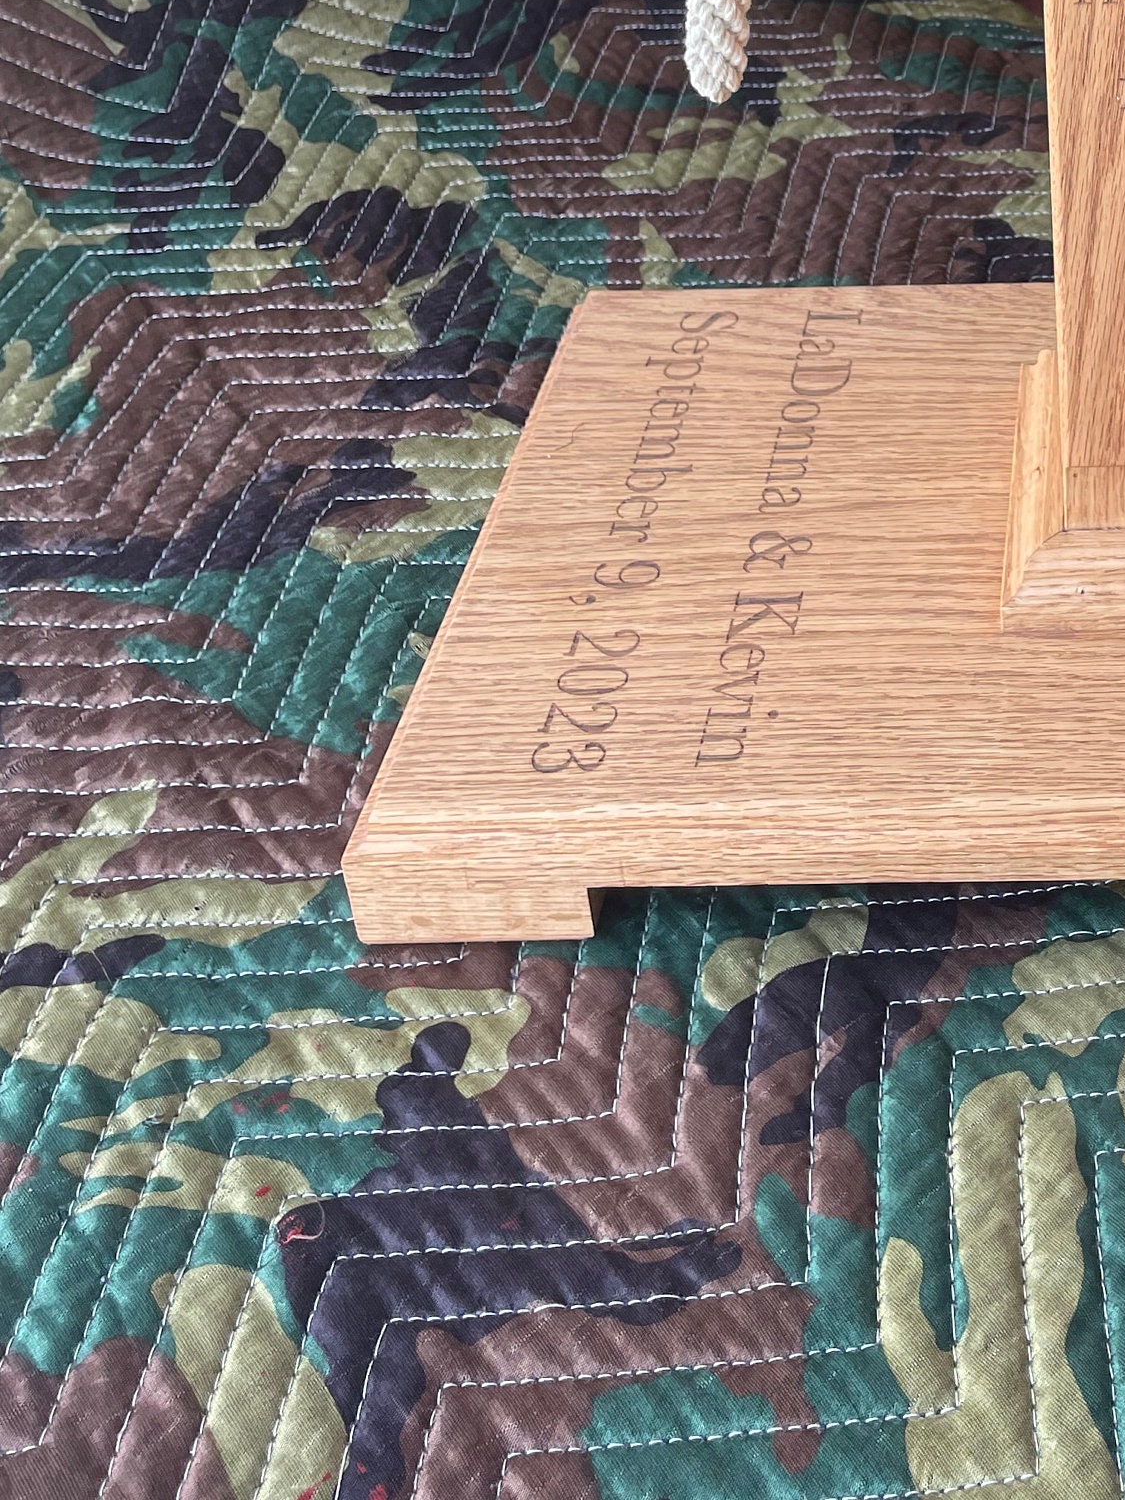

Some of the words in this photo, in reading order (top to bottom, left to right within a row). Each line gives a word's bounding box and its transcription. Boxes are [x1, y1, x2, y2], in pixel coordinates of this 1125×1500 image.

[608, 310, 740, 544] September
[757, 308, 864, 514] LaDonna
[568, 559, 662, 606] 9,
[742, 530, 814, 573] &
[531, 628, 641, 774] 2023
[694, 591, 805, 768] Kevin
